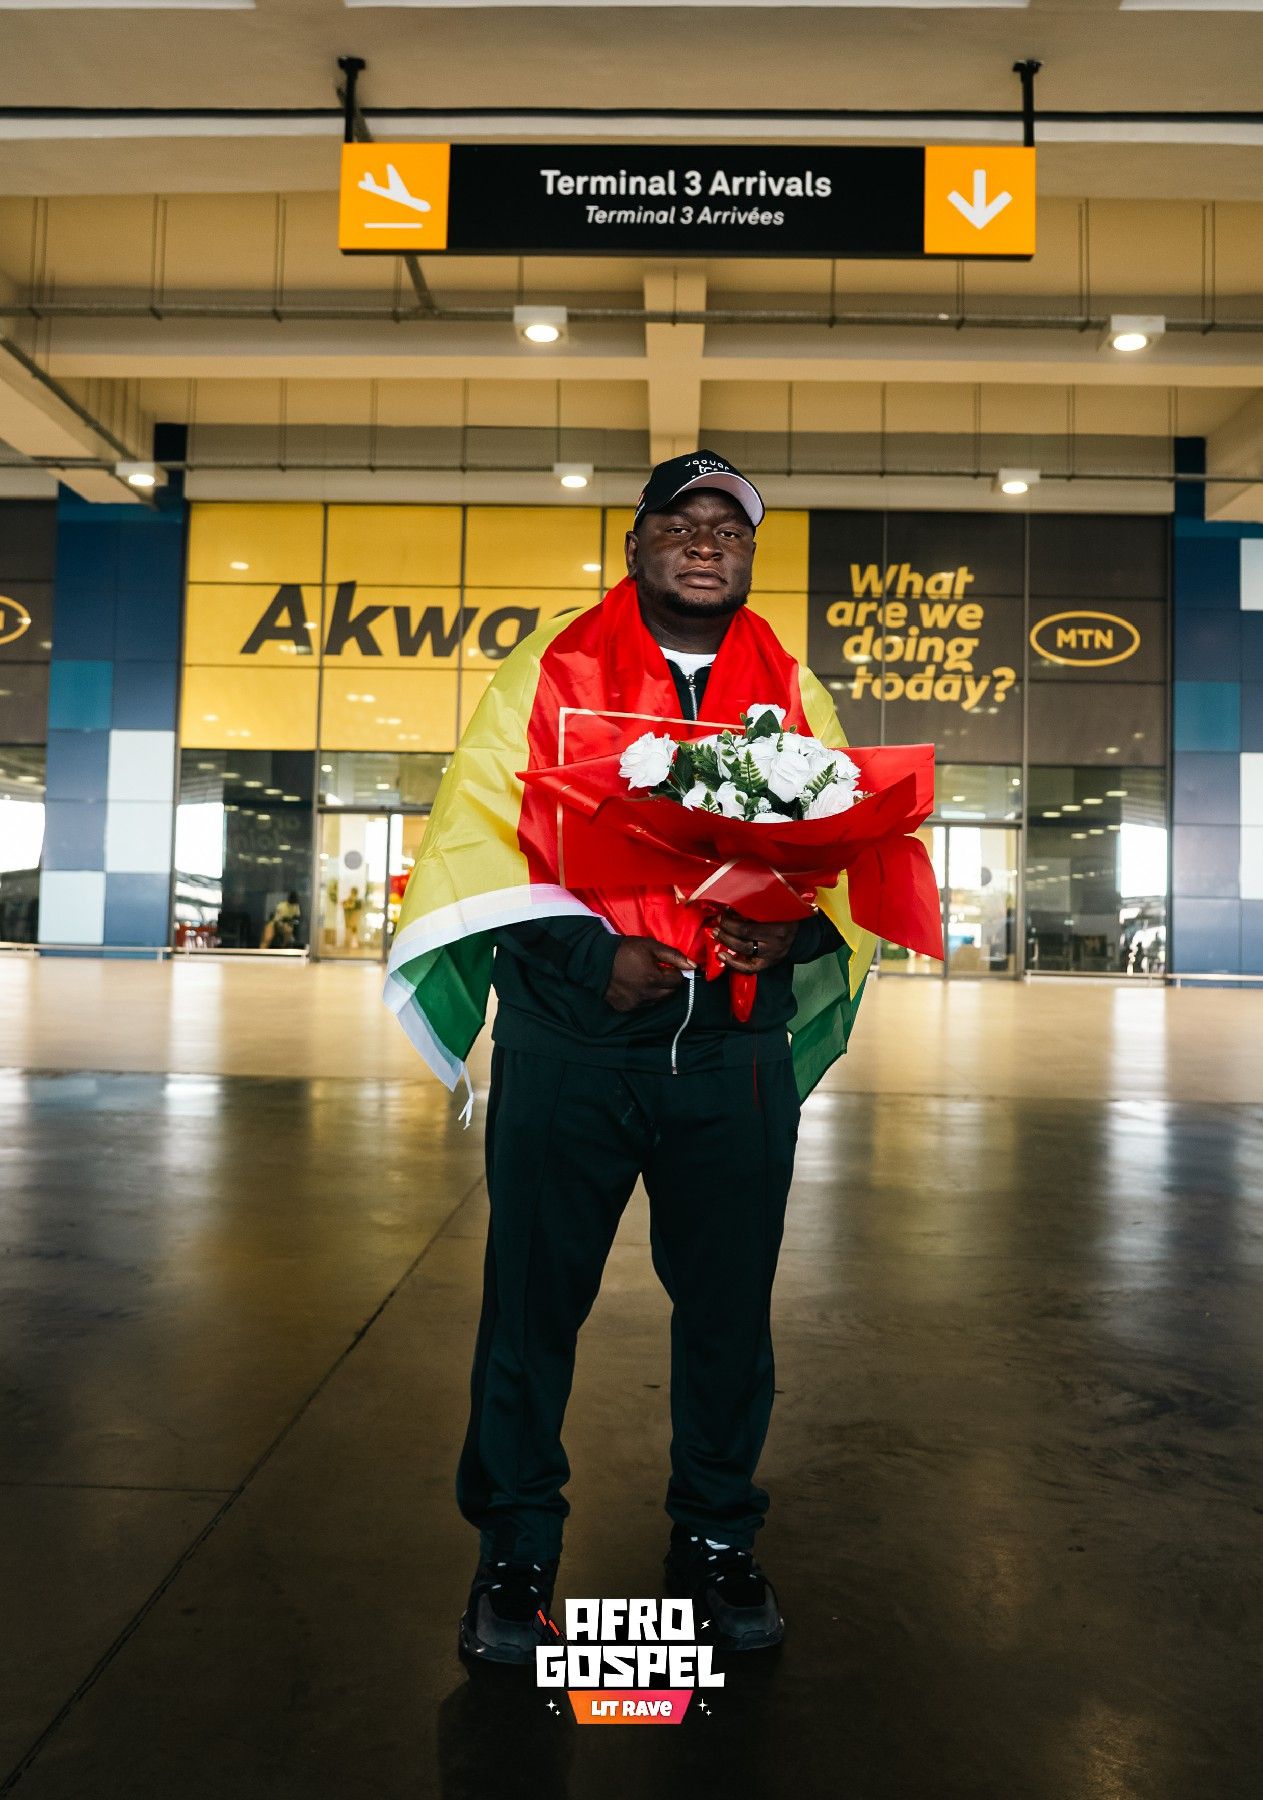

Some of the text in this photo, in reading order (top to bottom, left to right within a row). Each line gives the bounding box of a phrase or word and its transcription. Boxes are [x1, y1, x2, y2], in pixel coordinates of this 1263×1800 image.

[540, 169, 832, 197] Terminal 3 Arrivals
[585, 205, 785, 226] Terminal 3 Arrivées
[850, 563, 975, 600] What
[239, 580, 583, 660] Akwa
[826, 600, 985, 631] are we
[842, 625, 980, 673] doing
[1055, 627, 1114, 650] MTN
[851, 664, 1017, 711] today?
